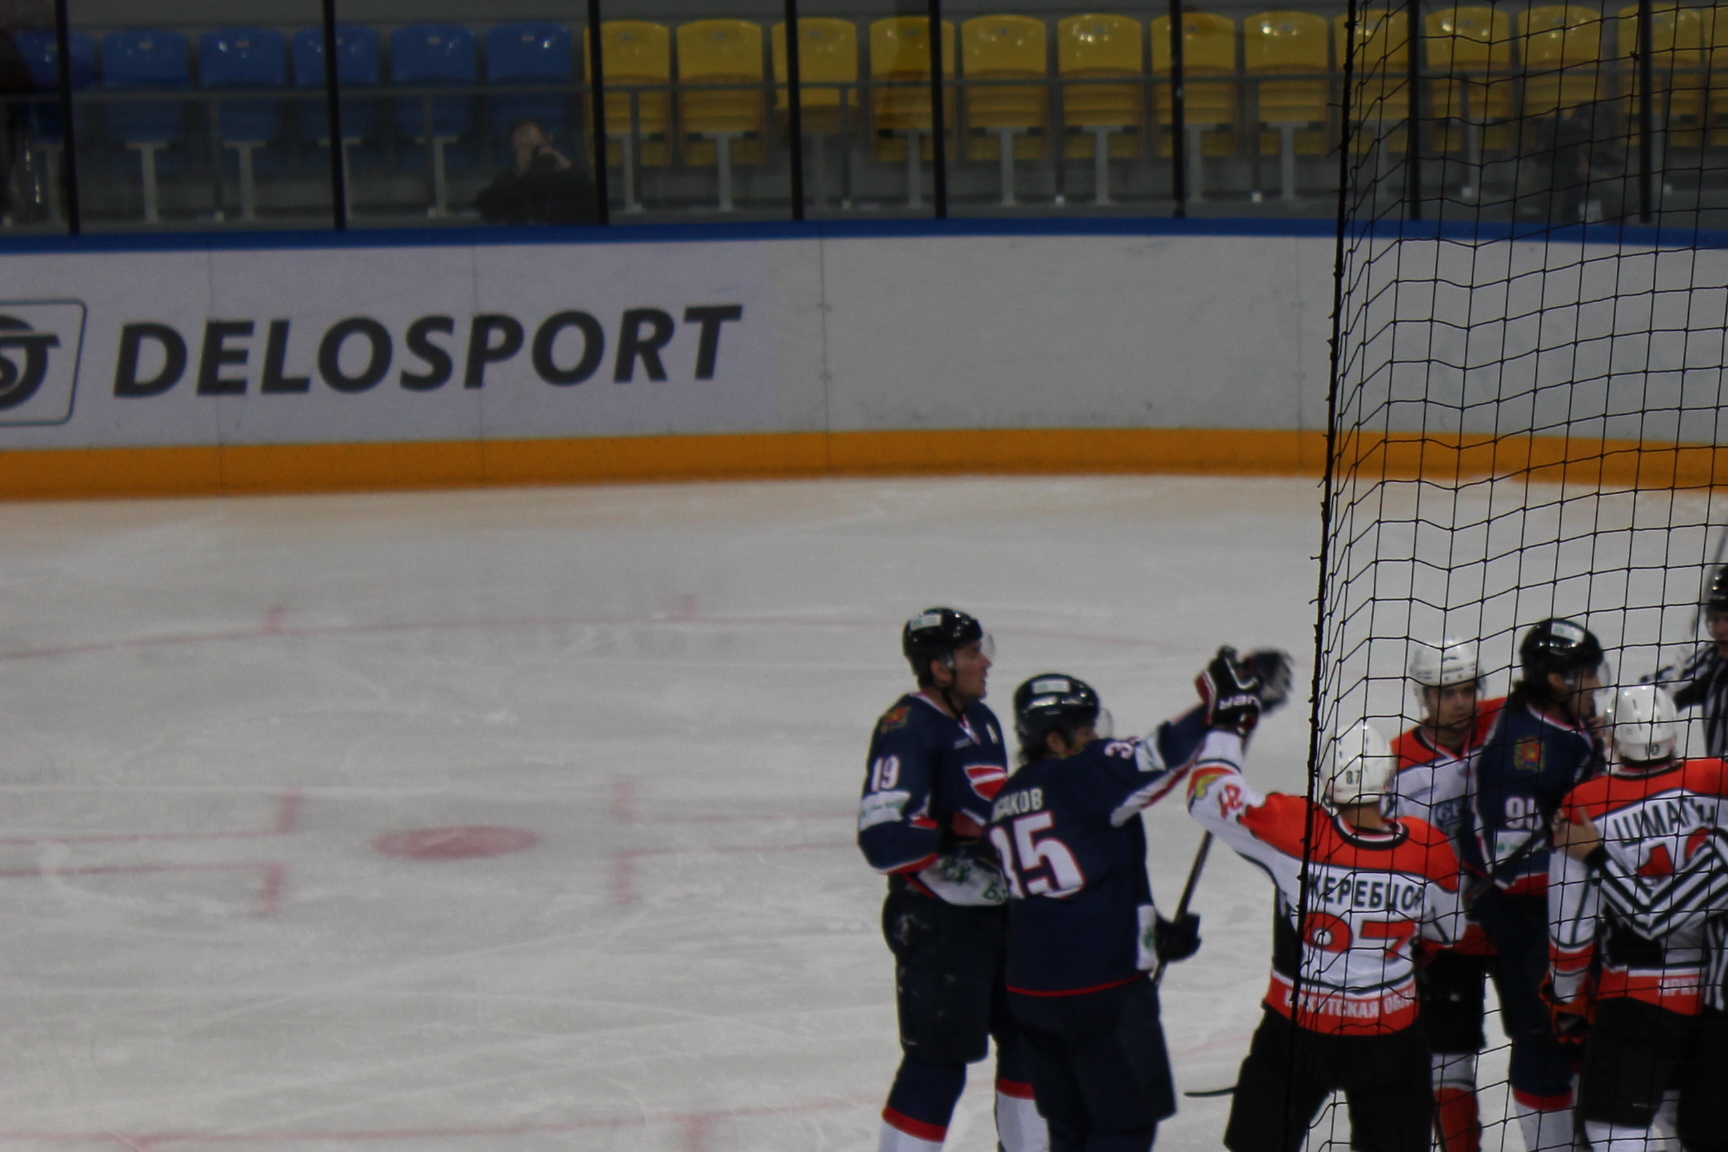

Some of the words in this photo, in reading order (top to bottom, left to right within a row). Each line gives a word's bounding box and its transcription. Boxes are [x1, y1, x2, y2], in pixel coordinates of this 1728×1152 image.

[113, 304, 743, 398] DELOSPORT
[871, 755, 900, 793] 19
[1345, 769, 1361, 785] 87
